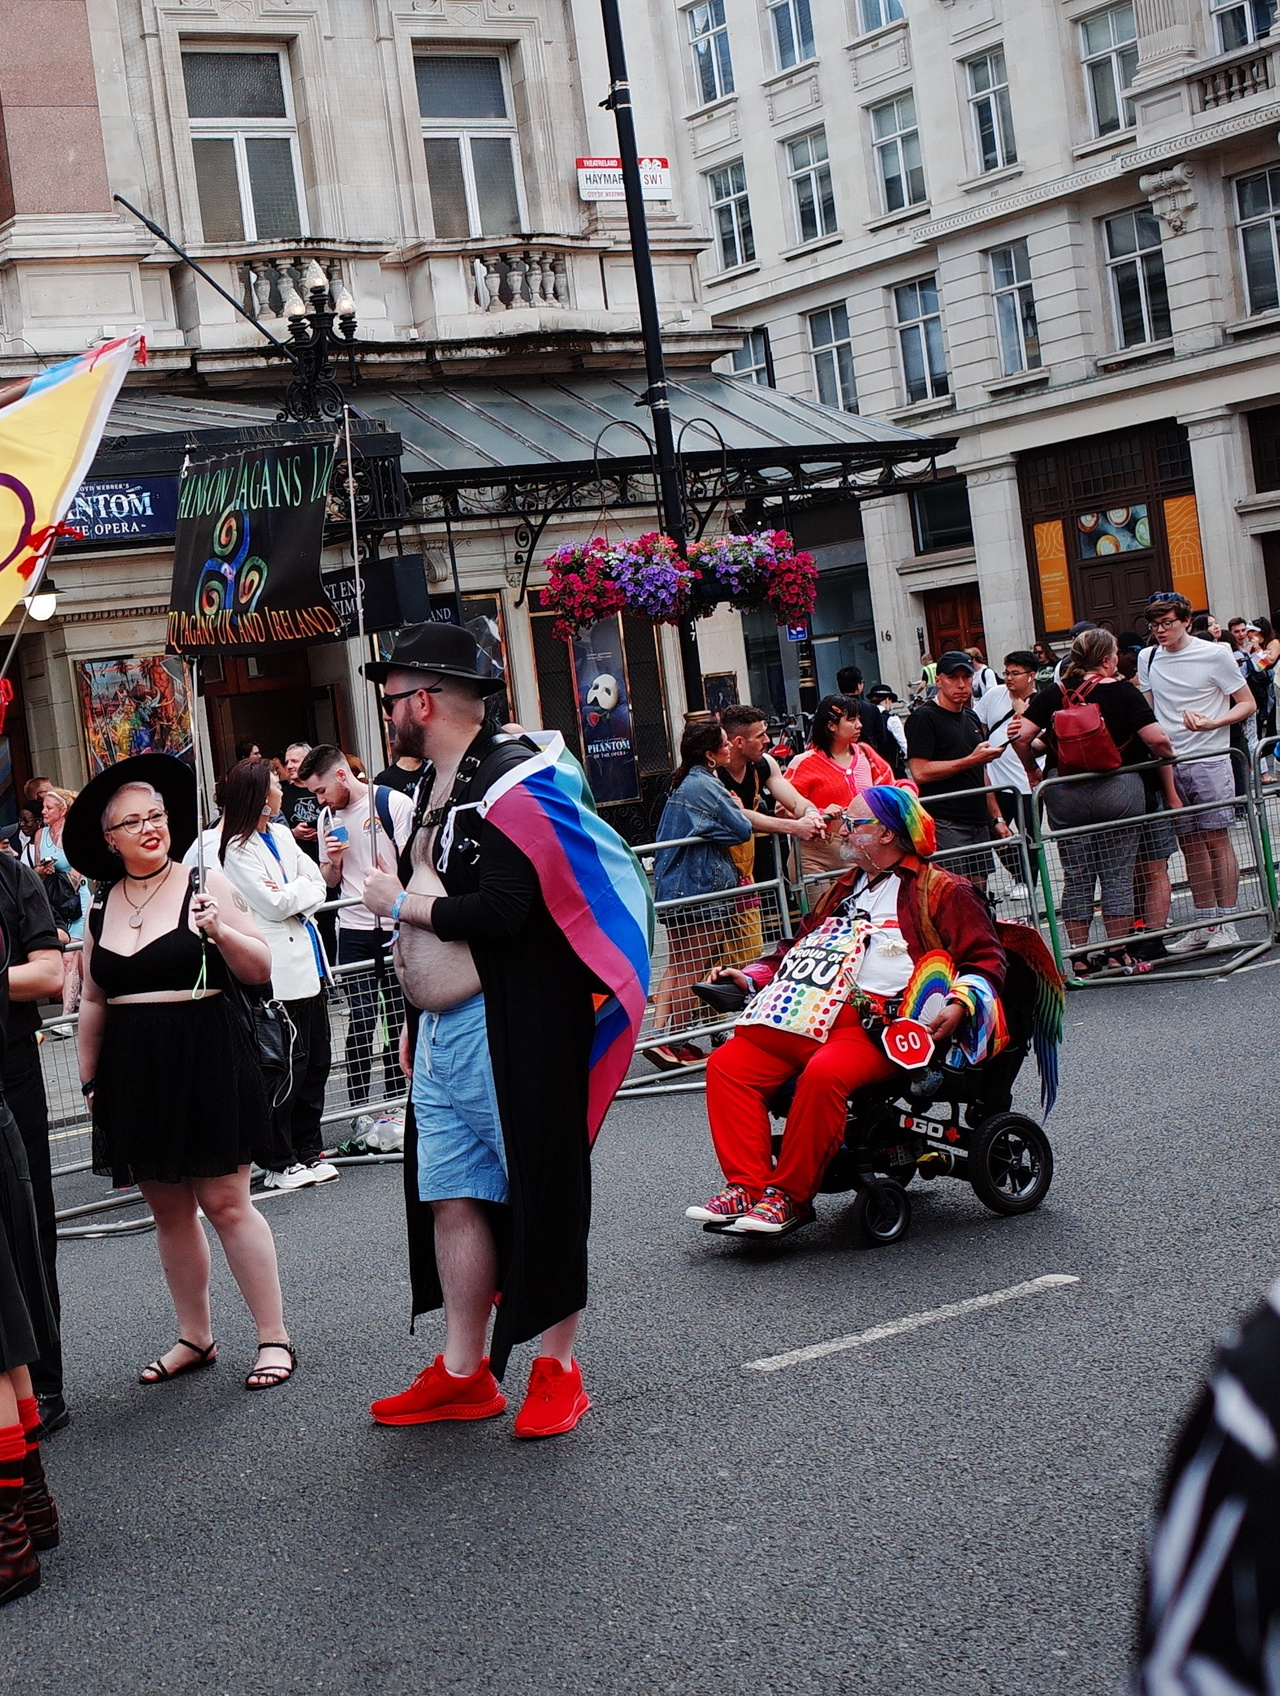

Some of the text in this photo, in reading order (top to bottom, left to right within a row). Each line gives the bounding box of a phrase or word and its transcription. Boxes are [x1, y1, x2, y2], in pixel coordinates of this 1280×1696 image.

[644, 174, 663, 185] SW1
[94, 522, 140, 536] OPERA
[180, 610, 216, 646] PAGANS
[217, 608, 239, 644] UK
[238, 612, 266, 644] AND
[264, 605, 337, 642] IRELAND
[880, 630, 892, 642] 16
[587, 739, 631, 754] PHANTOM
[788, 948, 845, 964] PROUD OF
[780, 957, 841, 985] YOU
[895, 1031, 921, 1053] GO
